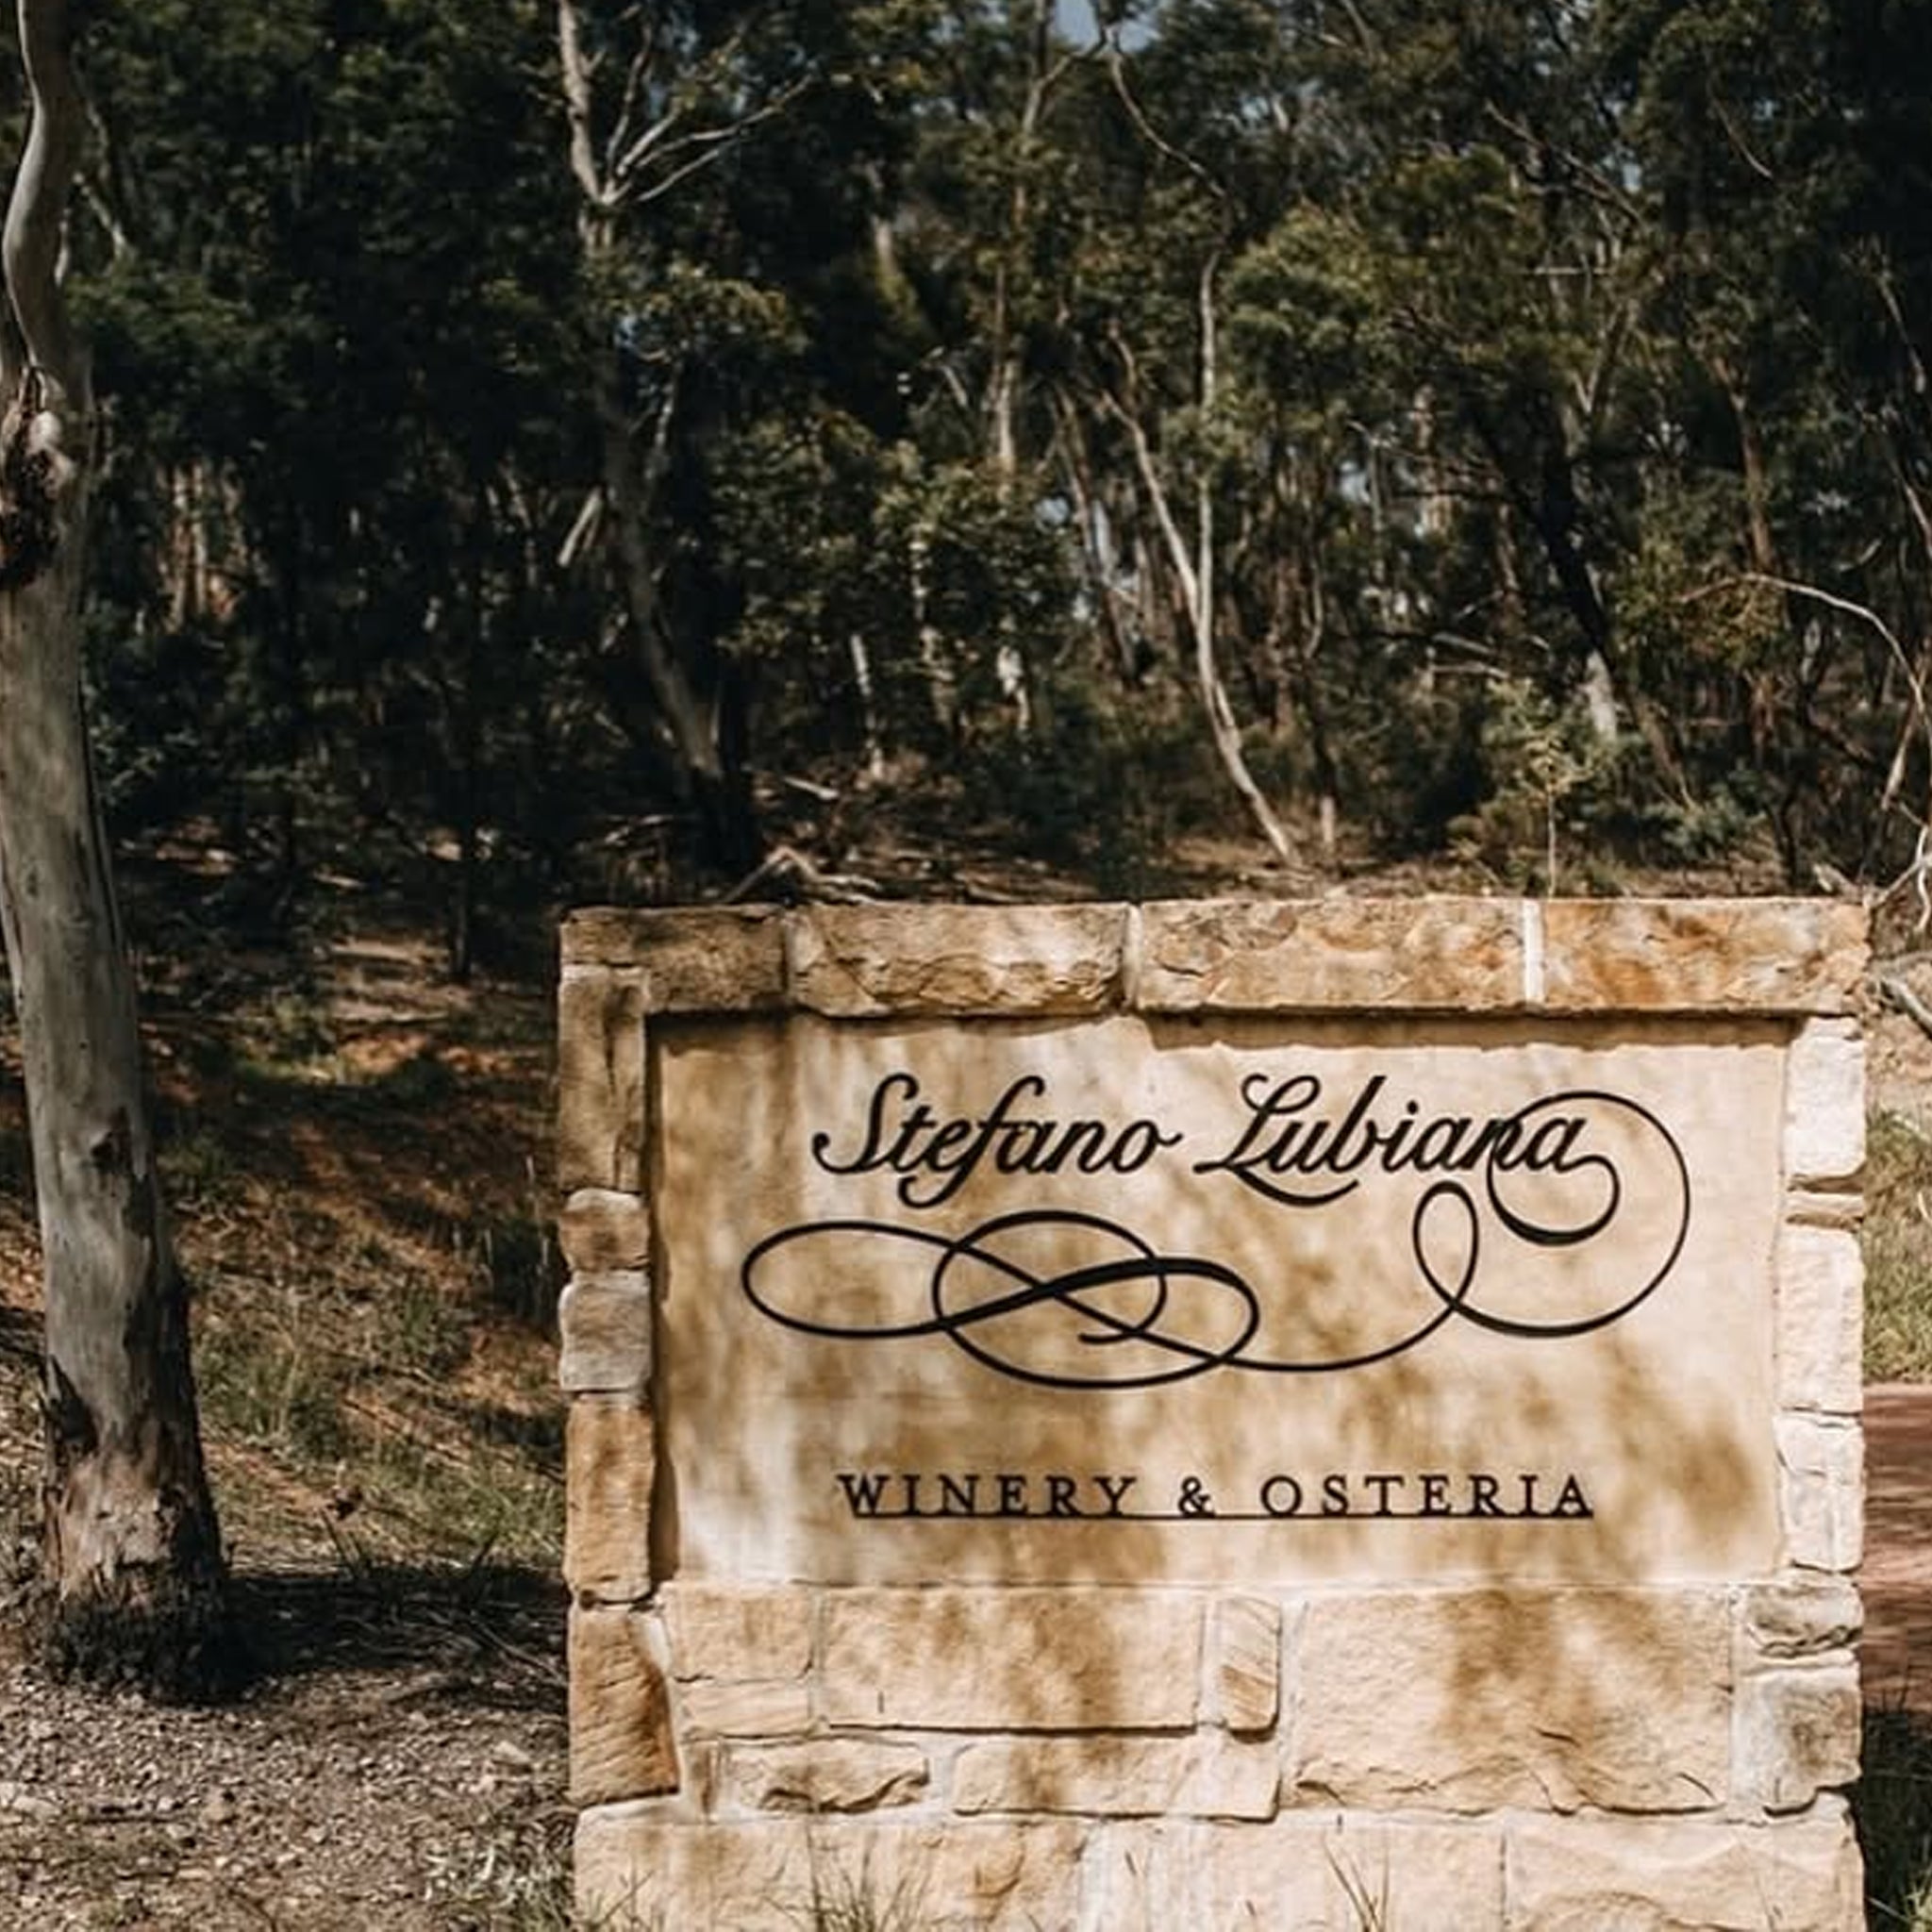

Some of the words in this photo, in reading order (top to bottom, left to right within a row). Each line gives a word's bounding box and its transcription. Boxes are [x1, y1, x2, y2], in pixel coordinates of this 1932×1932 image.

[812, 1072, 1183, 1208] Stefano
[1192, 1074, 1594, 1208] Lubiana
[837, 1474, 1137, 1517] WINERY
[1177, 1475, 1216, 1517] &
[1259, 1474, 1594, 1518] OSTERIA
